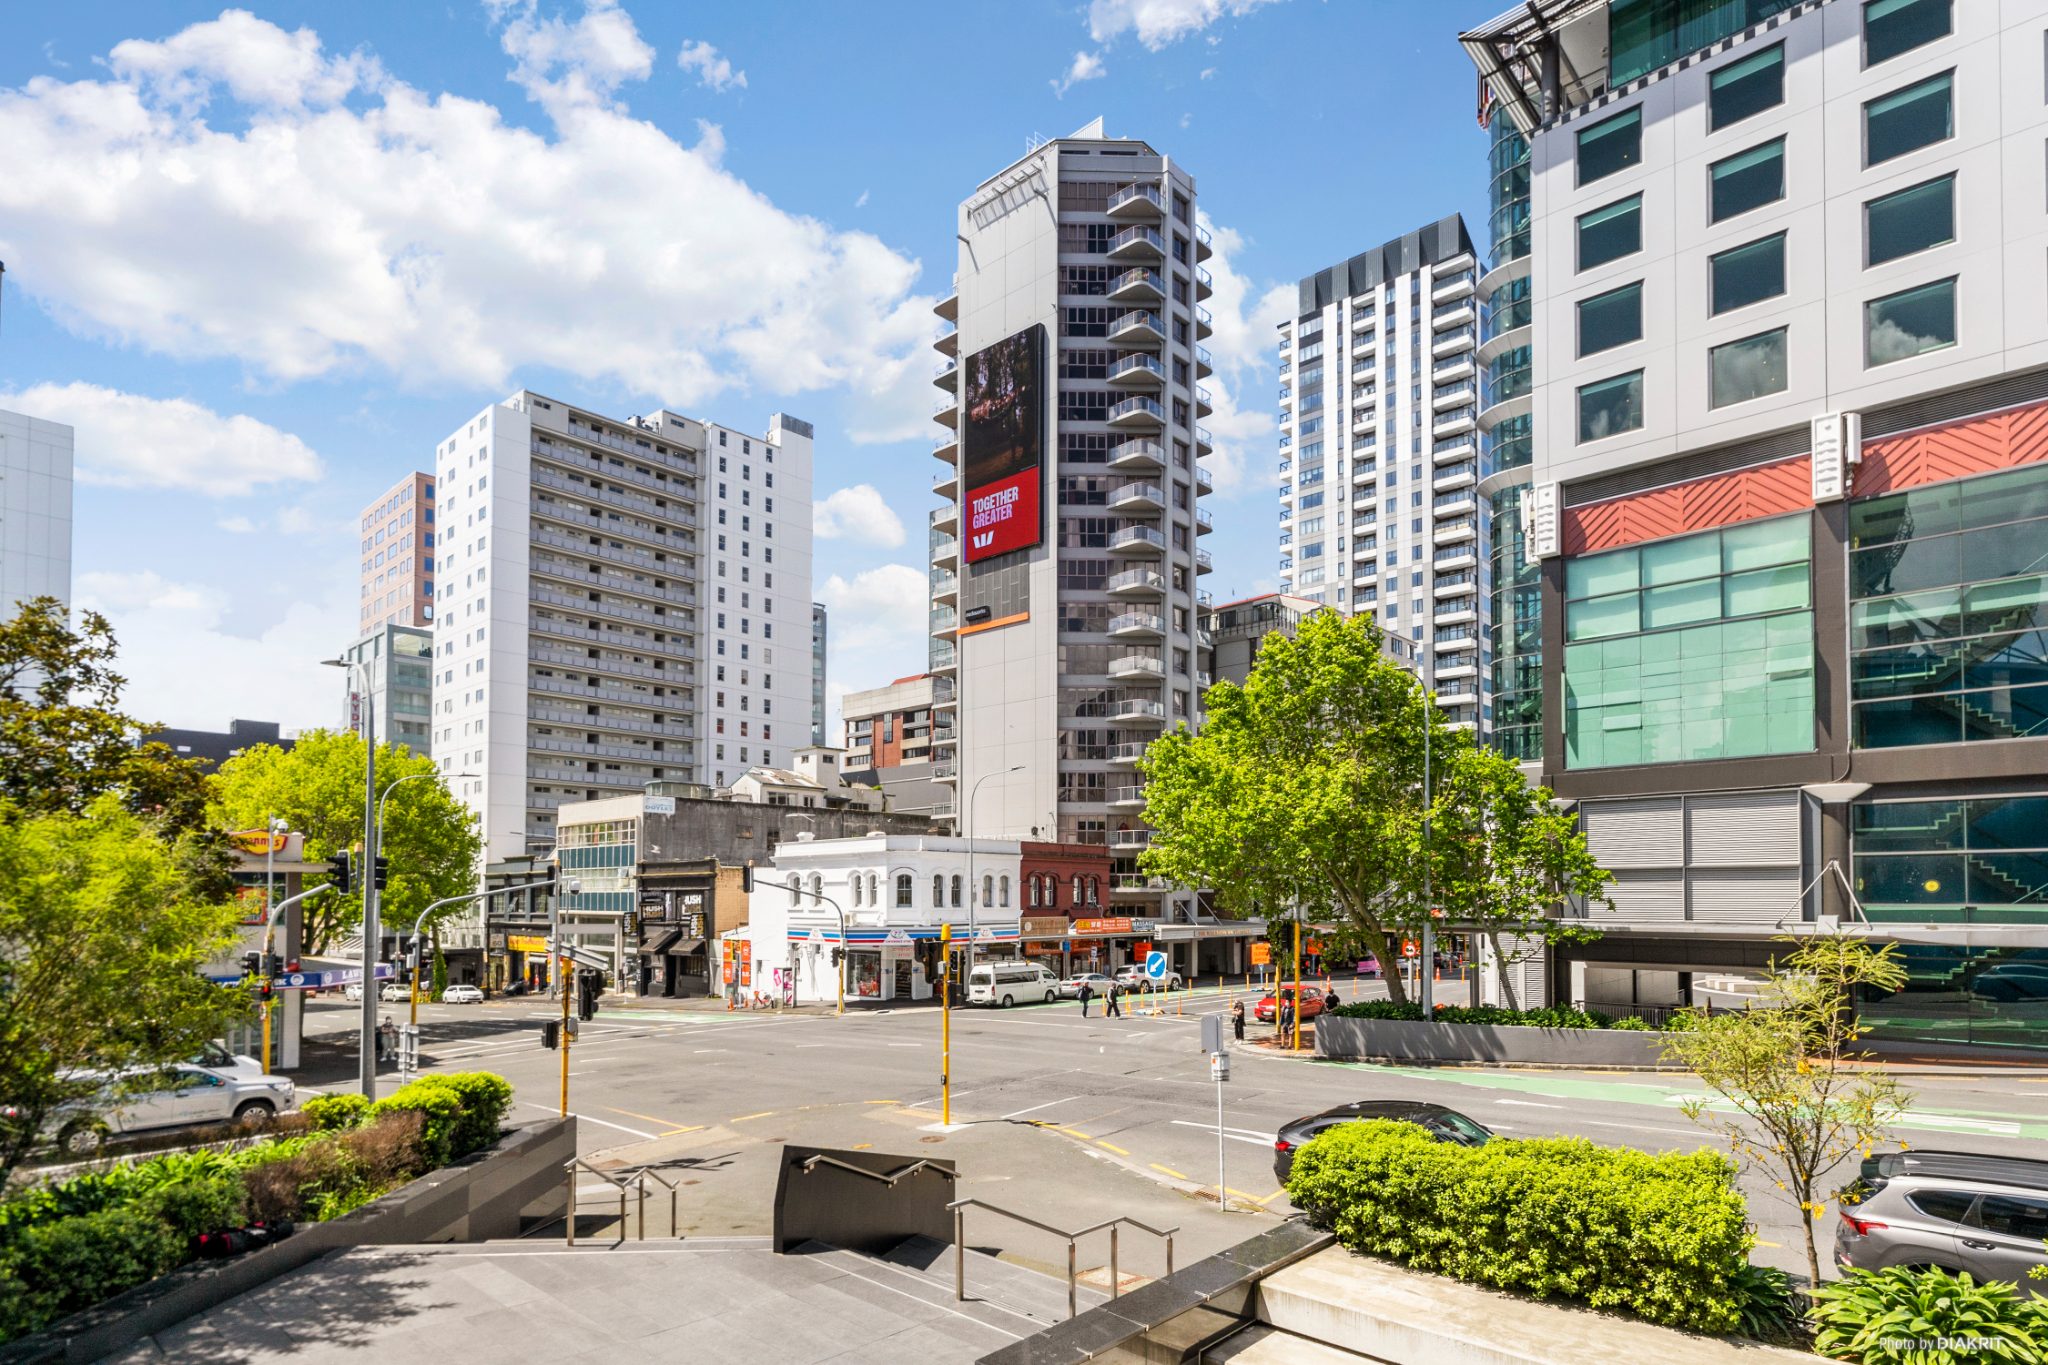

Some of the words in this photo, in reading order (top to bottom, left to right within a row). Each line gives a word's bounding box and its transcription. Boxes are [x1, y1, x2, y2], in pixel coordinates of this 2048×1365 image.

[972, 486, 1019, 515] TOGETHER
[972, 504, 1013, 530] GREATER
[351, 693, 360, 731] RYDG
